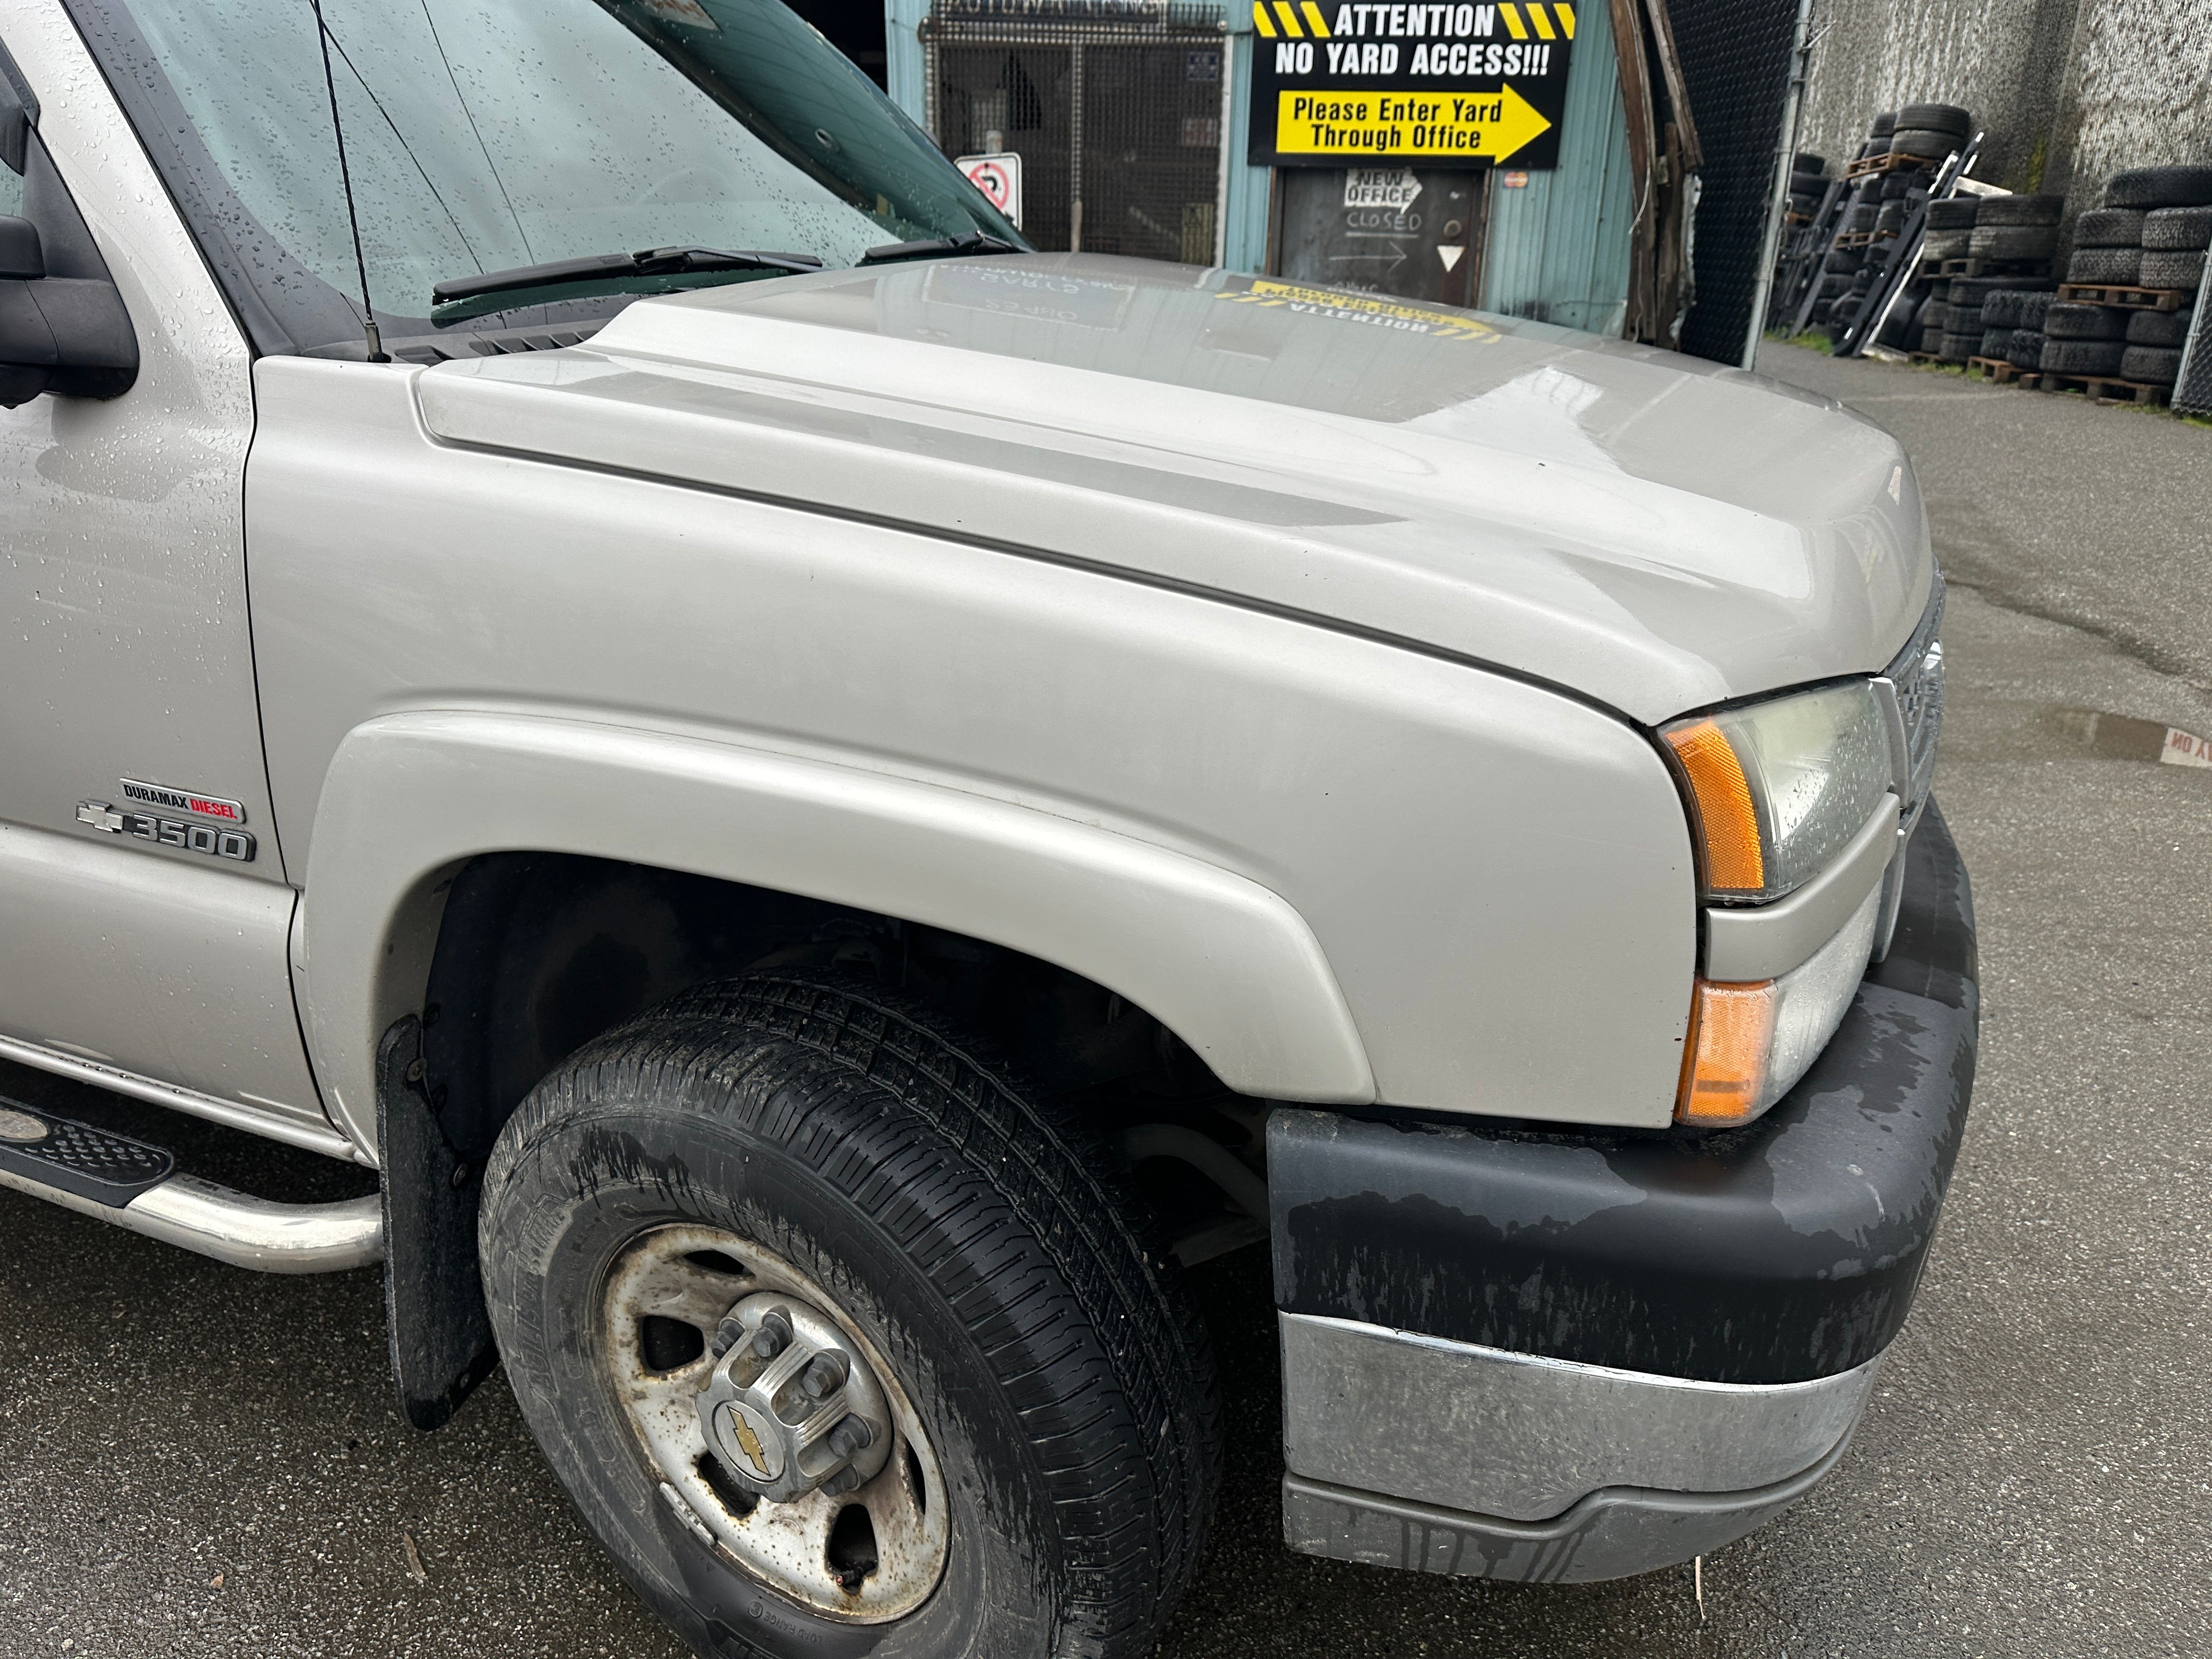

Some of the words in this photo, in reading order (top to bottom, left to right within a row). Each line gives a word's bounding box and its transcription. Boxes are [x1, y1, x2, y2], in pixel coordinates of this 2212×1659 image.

[1334, 3, 1495, 37] ATTENTION
[1275, 42, 1314, 74] NO
[1326, 43, 1400, 75] YARD
[1409, 43, 1551, 77] ACCESS!!!
[1294, 97, 1368, 122] Please
[1379, 98, 1441, 122] Enter
[1452, 99, 1502, 123] Yard
[1311, 124, 1402, 151] Through
[1413, 125, 1481, 150] Office
[1355, 171, 1403, 186] NEW
[1347, 186, 1414, 203] OFFICE
[1346, 211, 1422, 231] CLOSED
[123, 783, 189, 810] DURAMAX
[190, 797, 238, 820] DIESEL
[132, 813, 249, 860] 3500
[763, 1611, 796, 1635] RANGE
